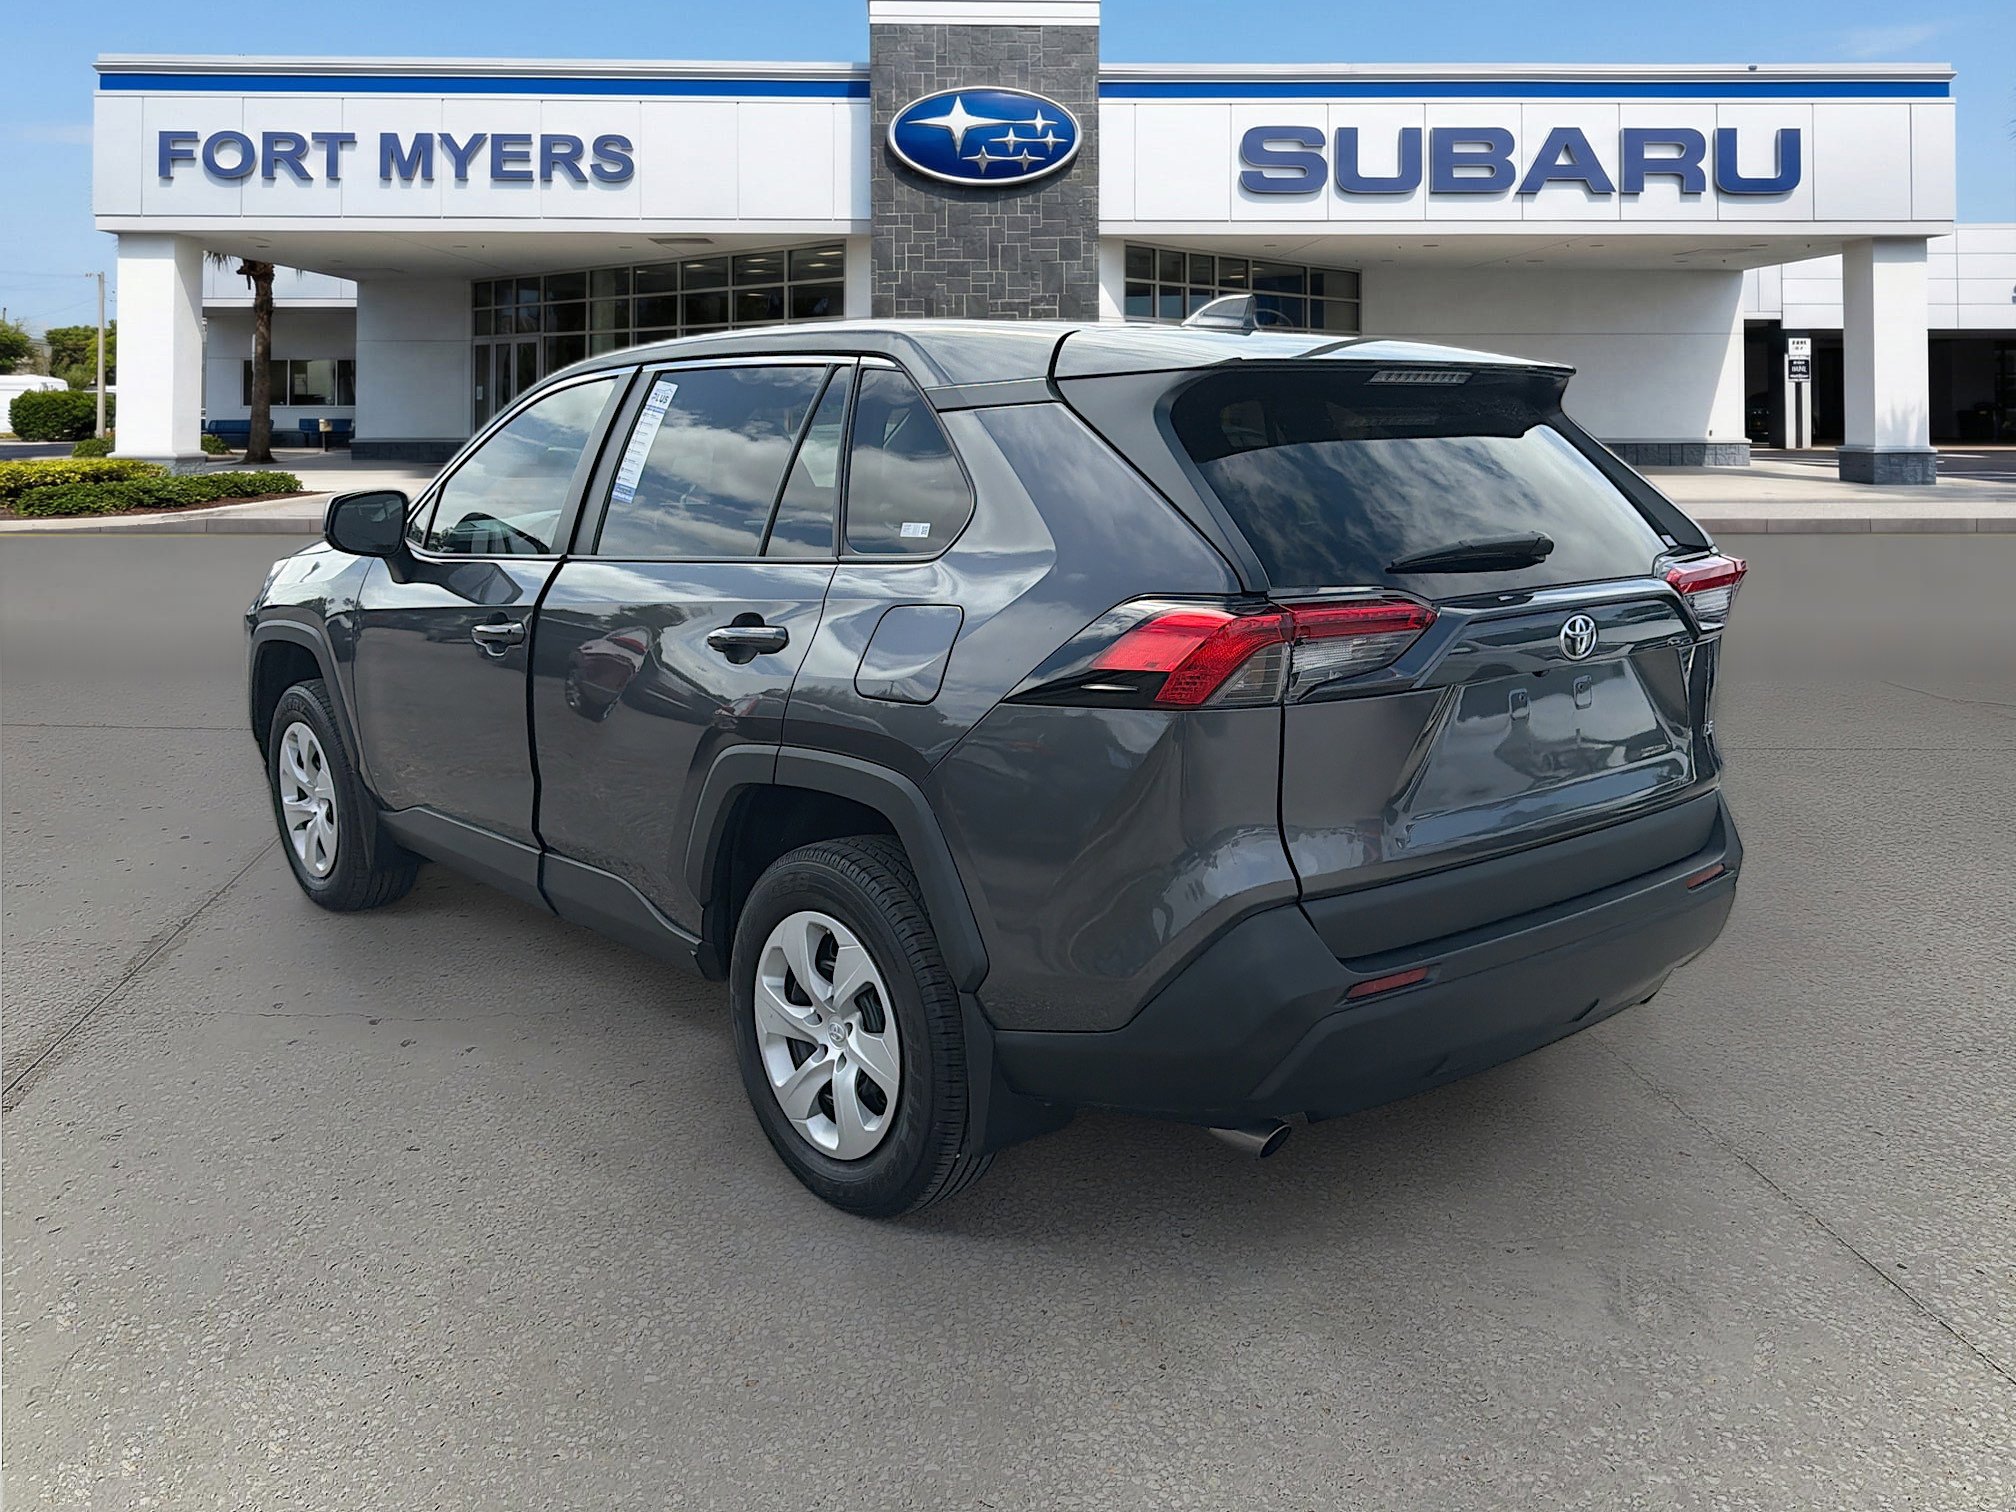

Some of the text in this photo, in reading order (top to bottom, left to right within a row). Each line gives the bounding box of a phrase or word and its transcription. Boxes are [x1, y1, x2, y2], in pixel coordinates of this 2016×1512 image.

[158, 130, 635, 187] FORT MYERS
[1239, 125, 1802, 198] SUBARU
